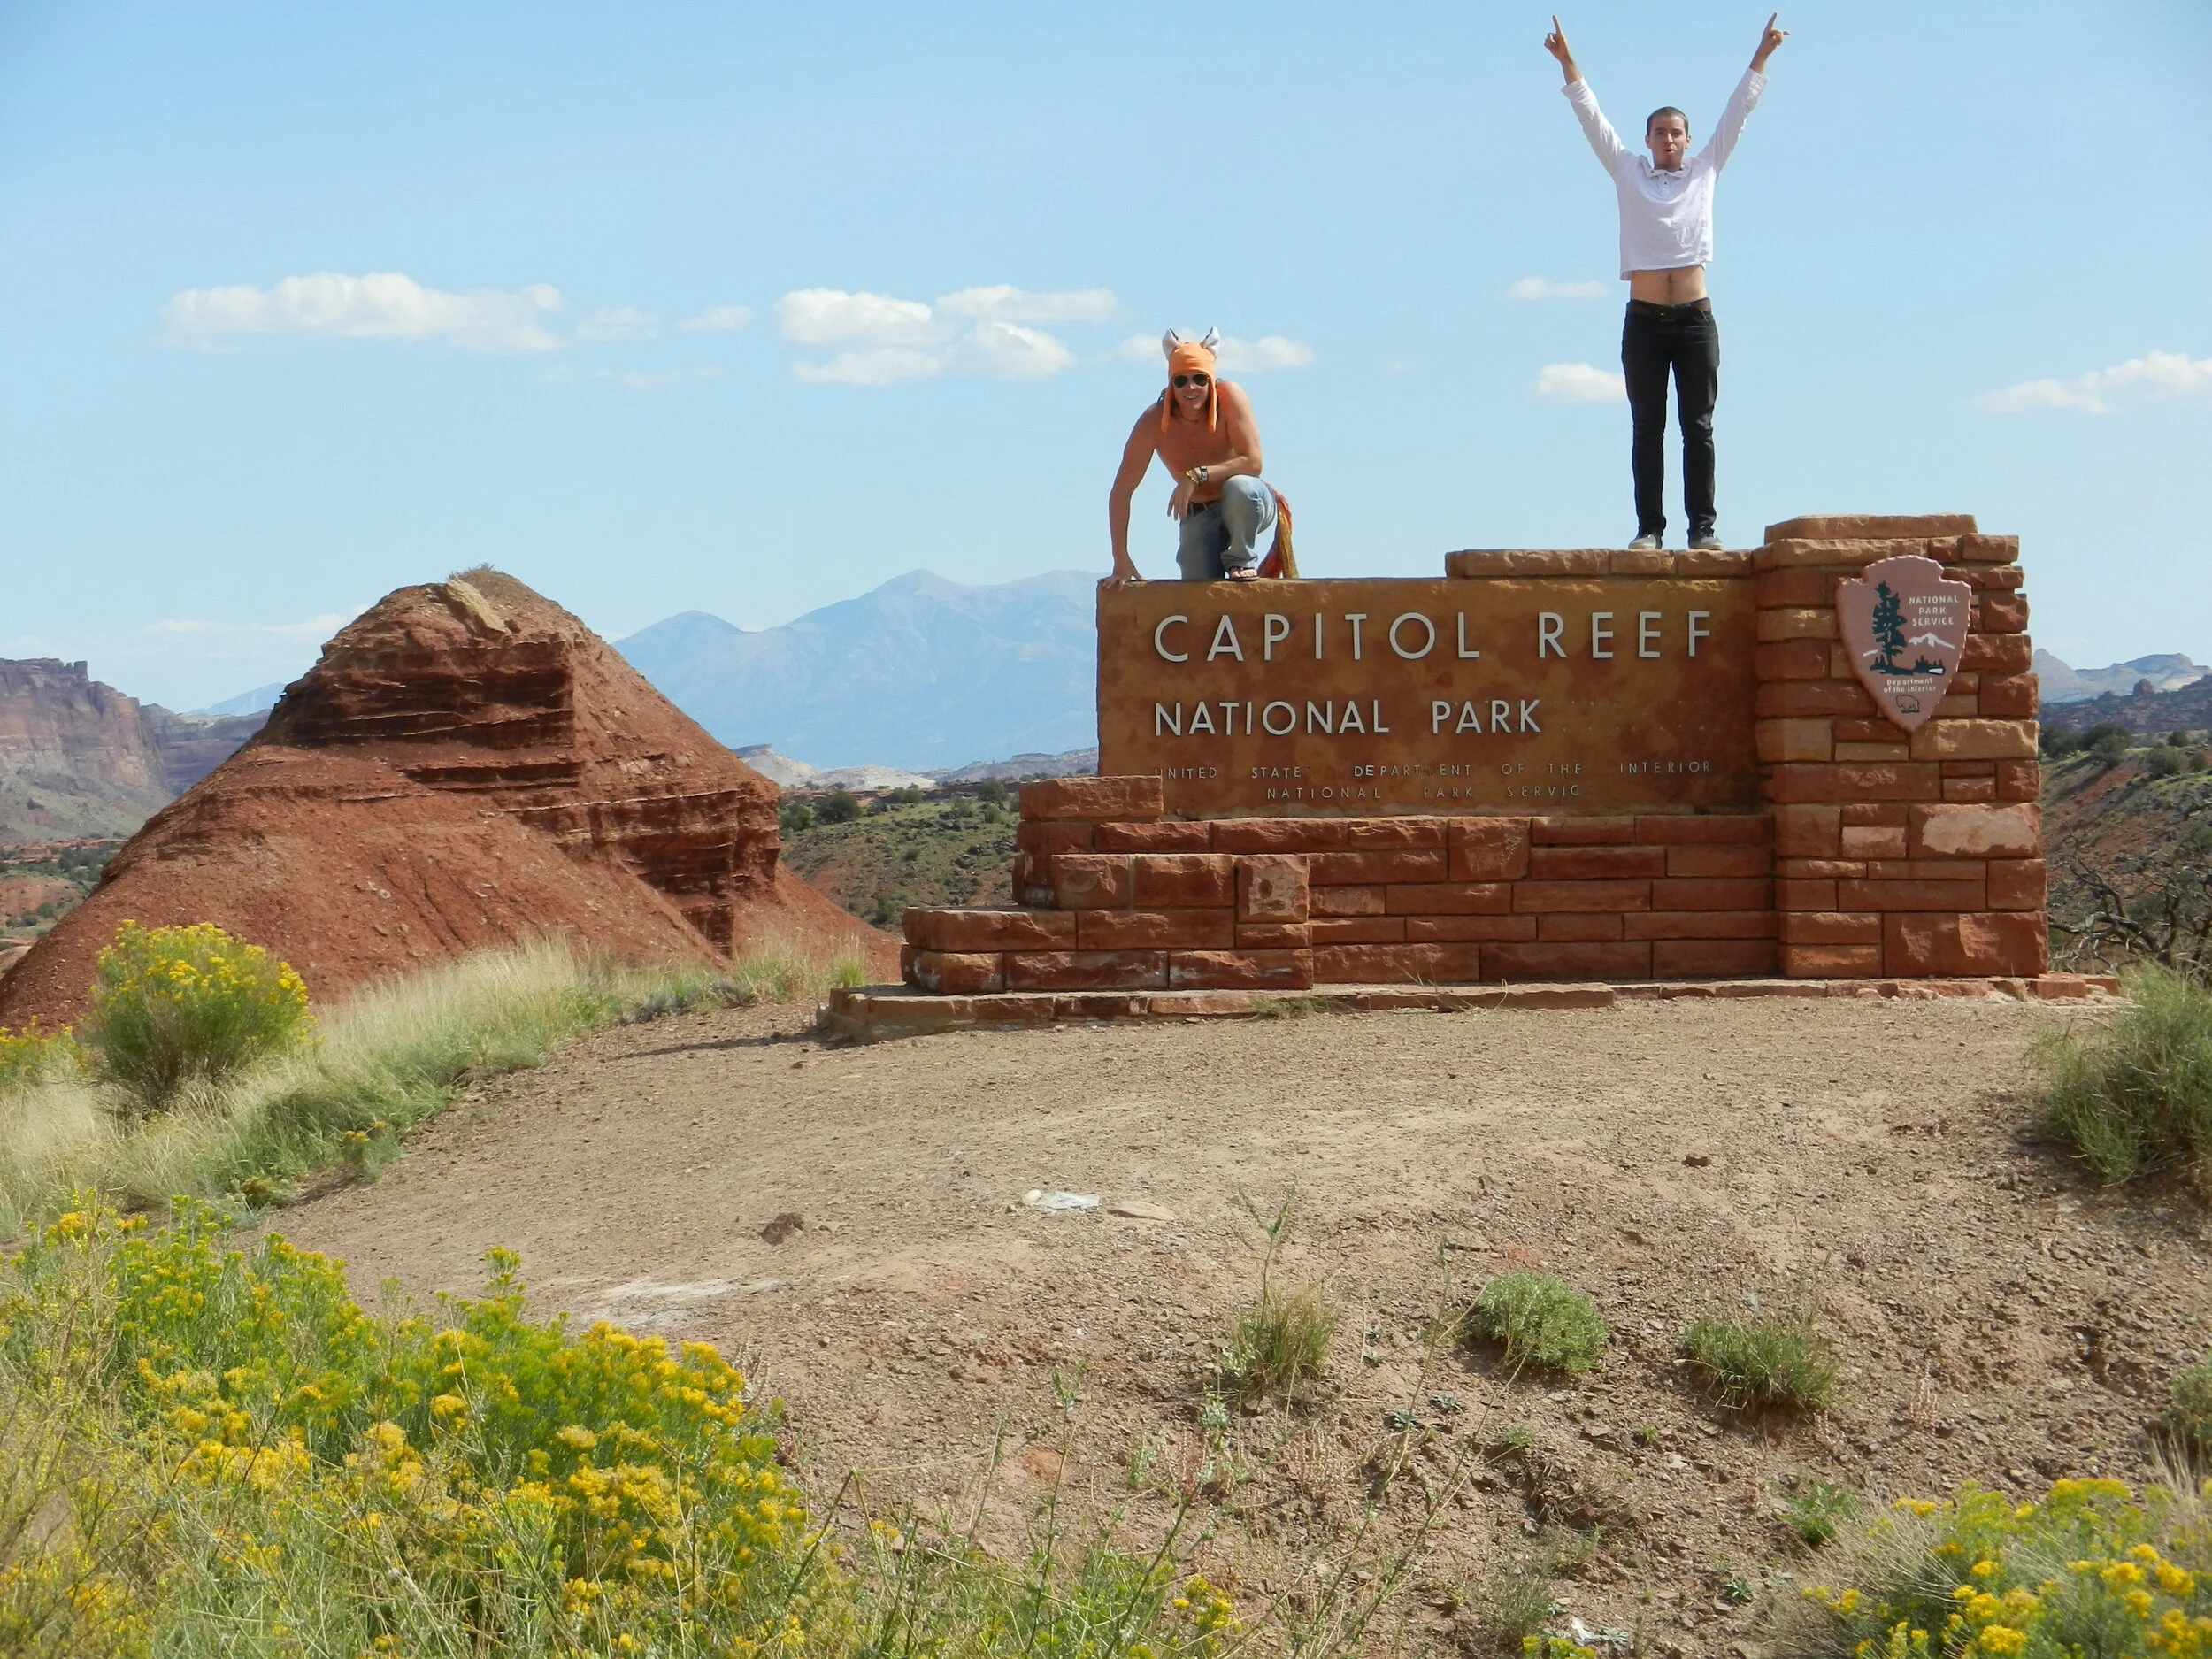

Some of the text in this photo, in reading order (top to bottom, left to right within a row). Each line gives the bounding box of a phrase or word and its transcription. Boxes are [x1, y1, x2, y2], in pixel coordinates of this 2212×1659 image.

[1909, 595, 1958, 605] NATIONAL
[1918, 606, 1947, 615] PARK
[1912, 617, 1954, 626] SERVICE
[1154, 611, 1710, 662] CAPITOL REEF
[1886, 677, 1932, 686] Department
[1155, 699, 1541, 736] NATIONAL PARK
[1155, 767, 1217, 779] UNITED
[1501, 764, 1526, 775] OF
[1549, 764, 1582, 775] THE
[1620, 761, 1710, 773] INTERIOR
[1267, 787, 1381, 799] NATIONAL
[1424, 787, 1472, 798] PARK
